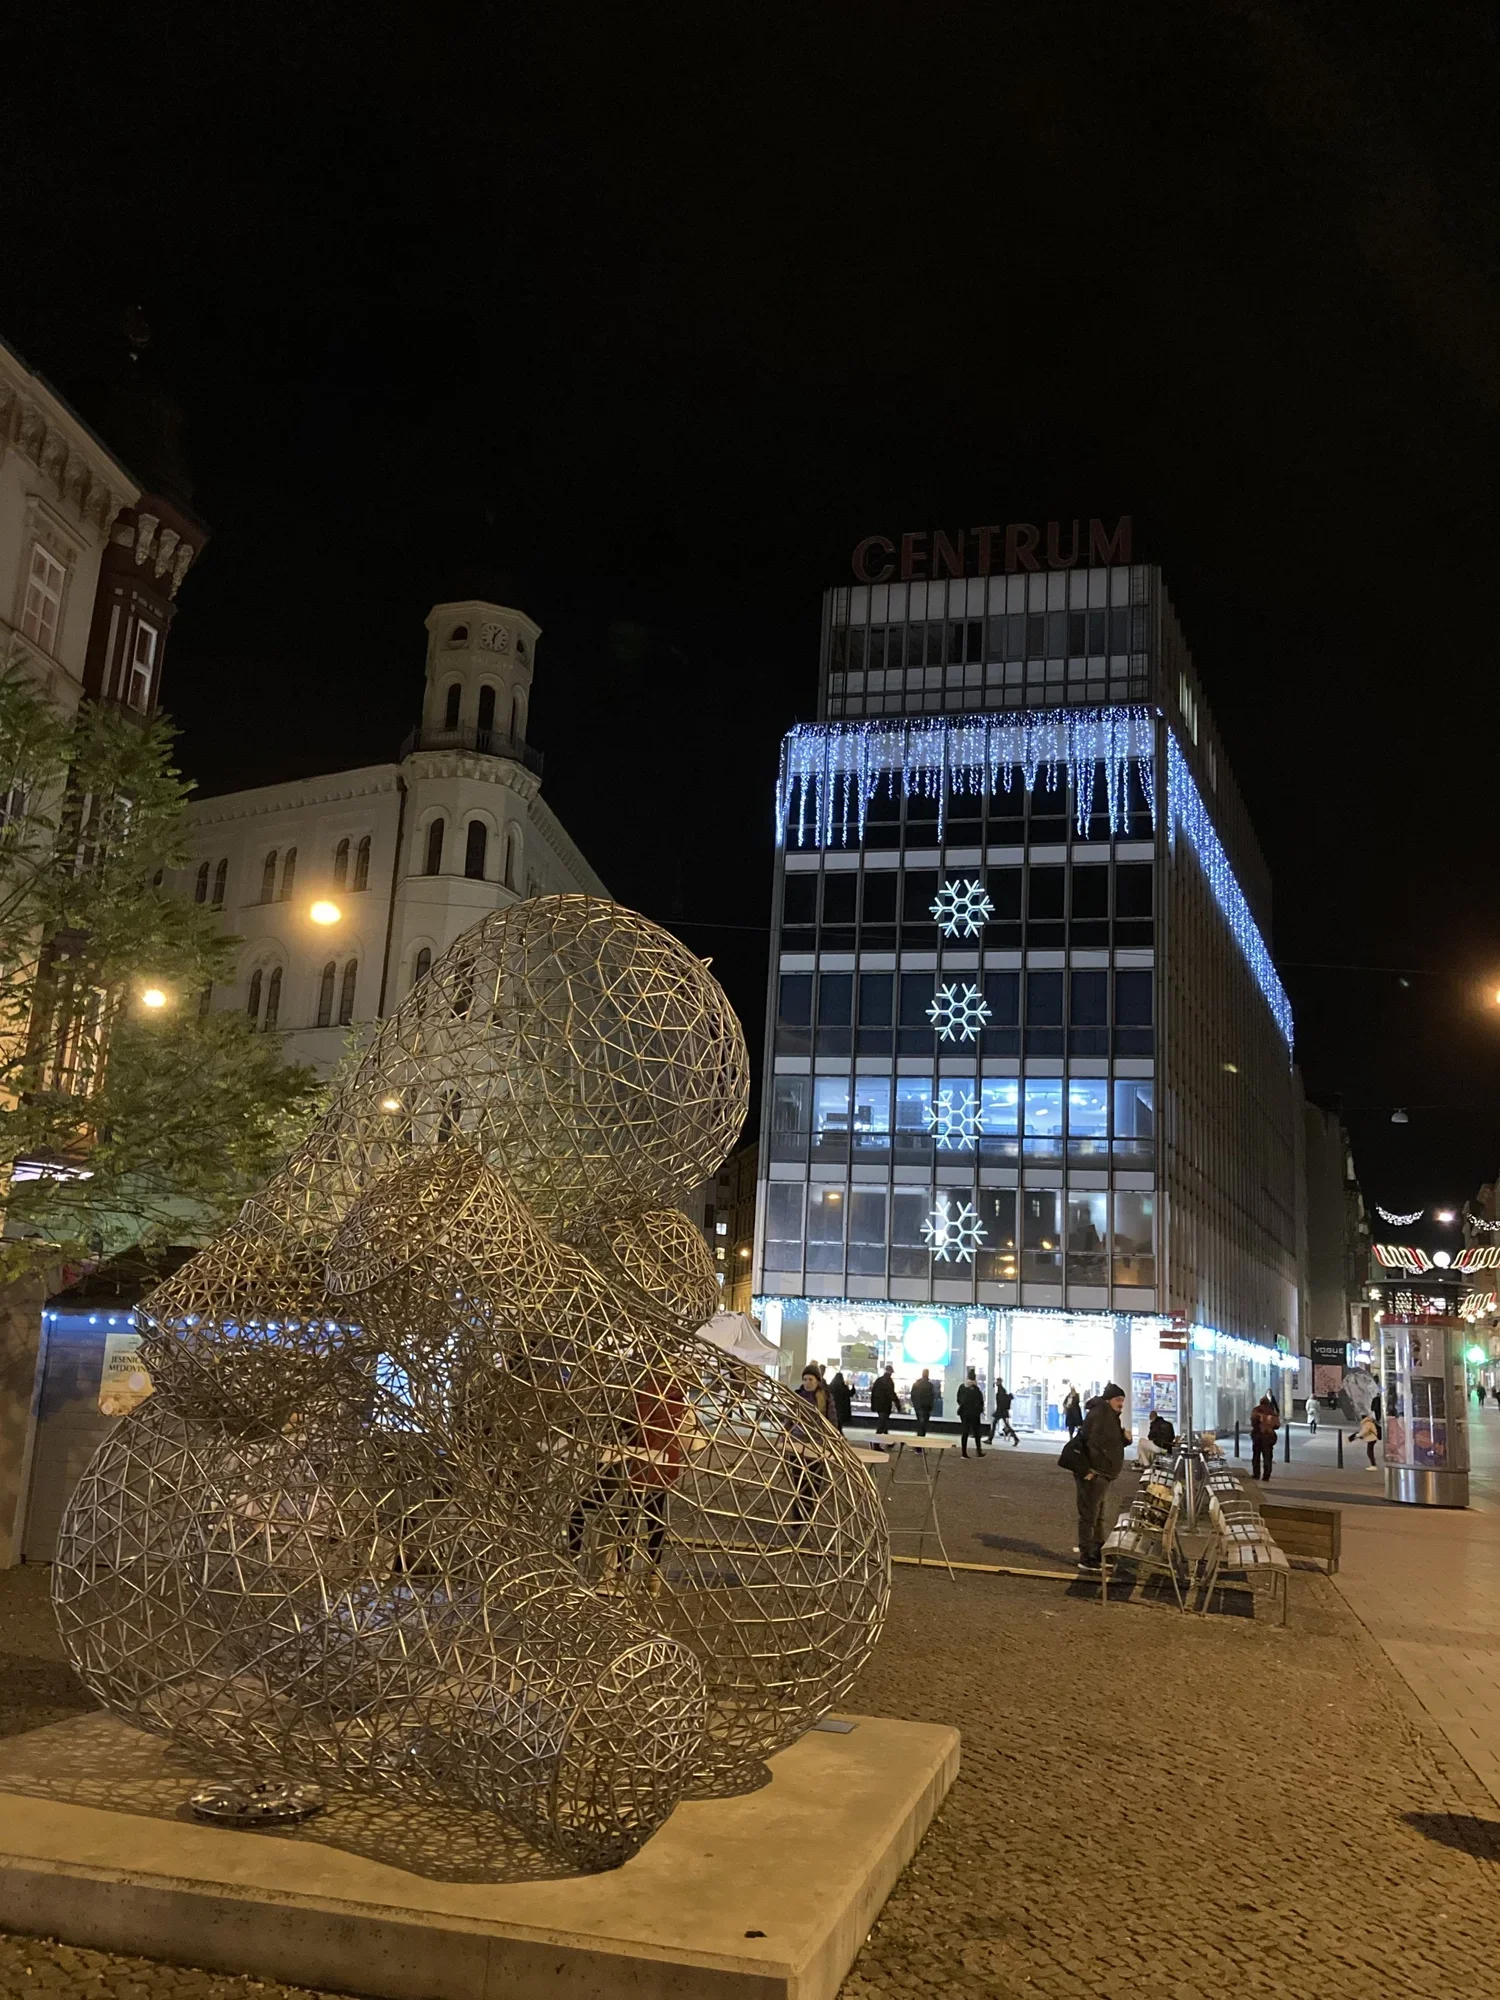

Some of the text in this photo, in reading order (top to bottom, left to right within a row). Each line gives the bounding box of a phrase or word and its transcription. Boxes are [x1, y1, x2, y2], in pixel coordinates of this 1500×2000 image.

[852, 516, 1132, 582] CENTRUM
[111, 1355, 141, 1364] JESENIC
[108, 1364, 147, 1373] MEDOVIN
